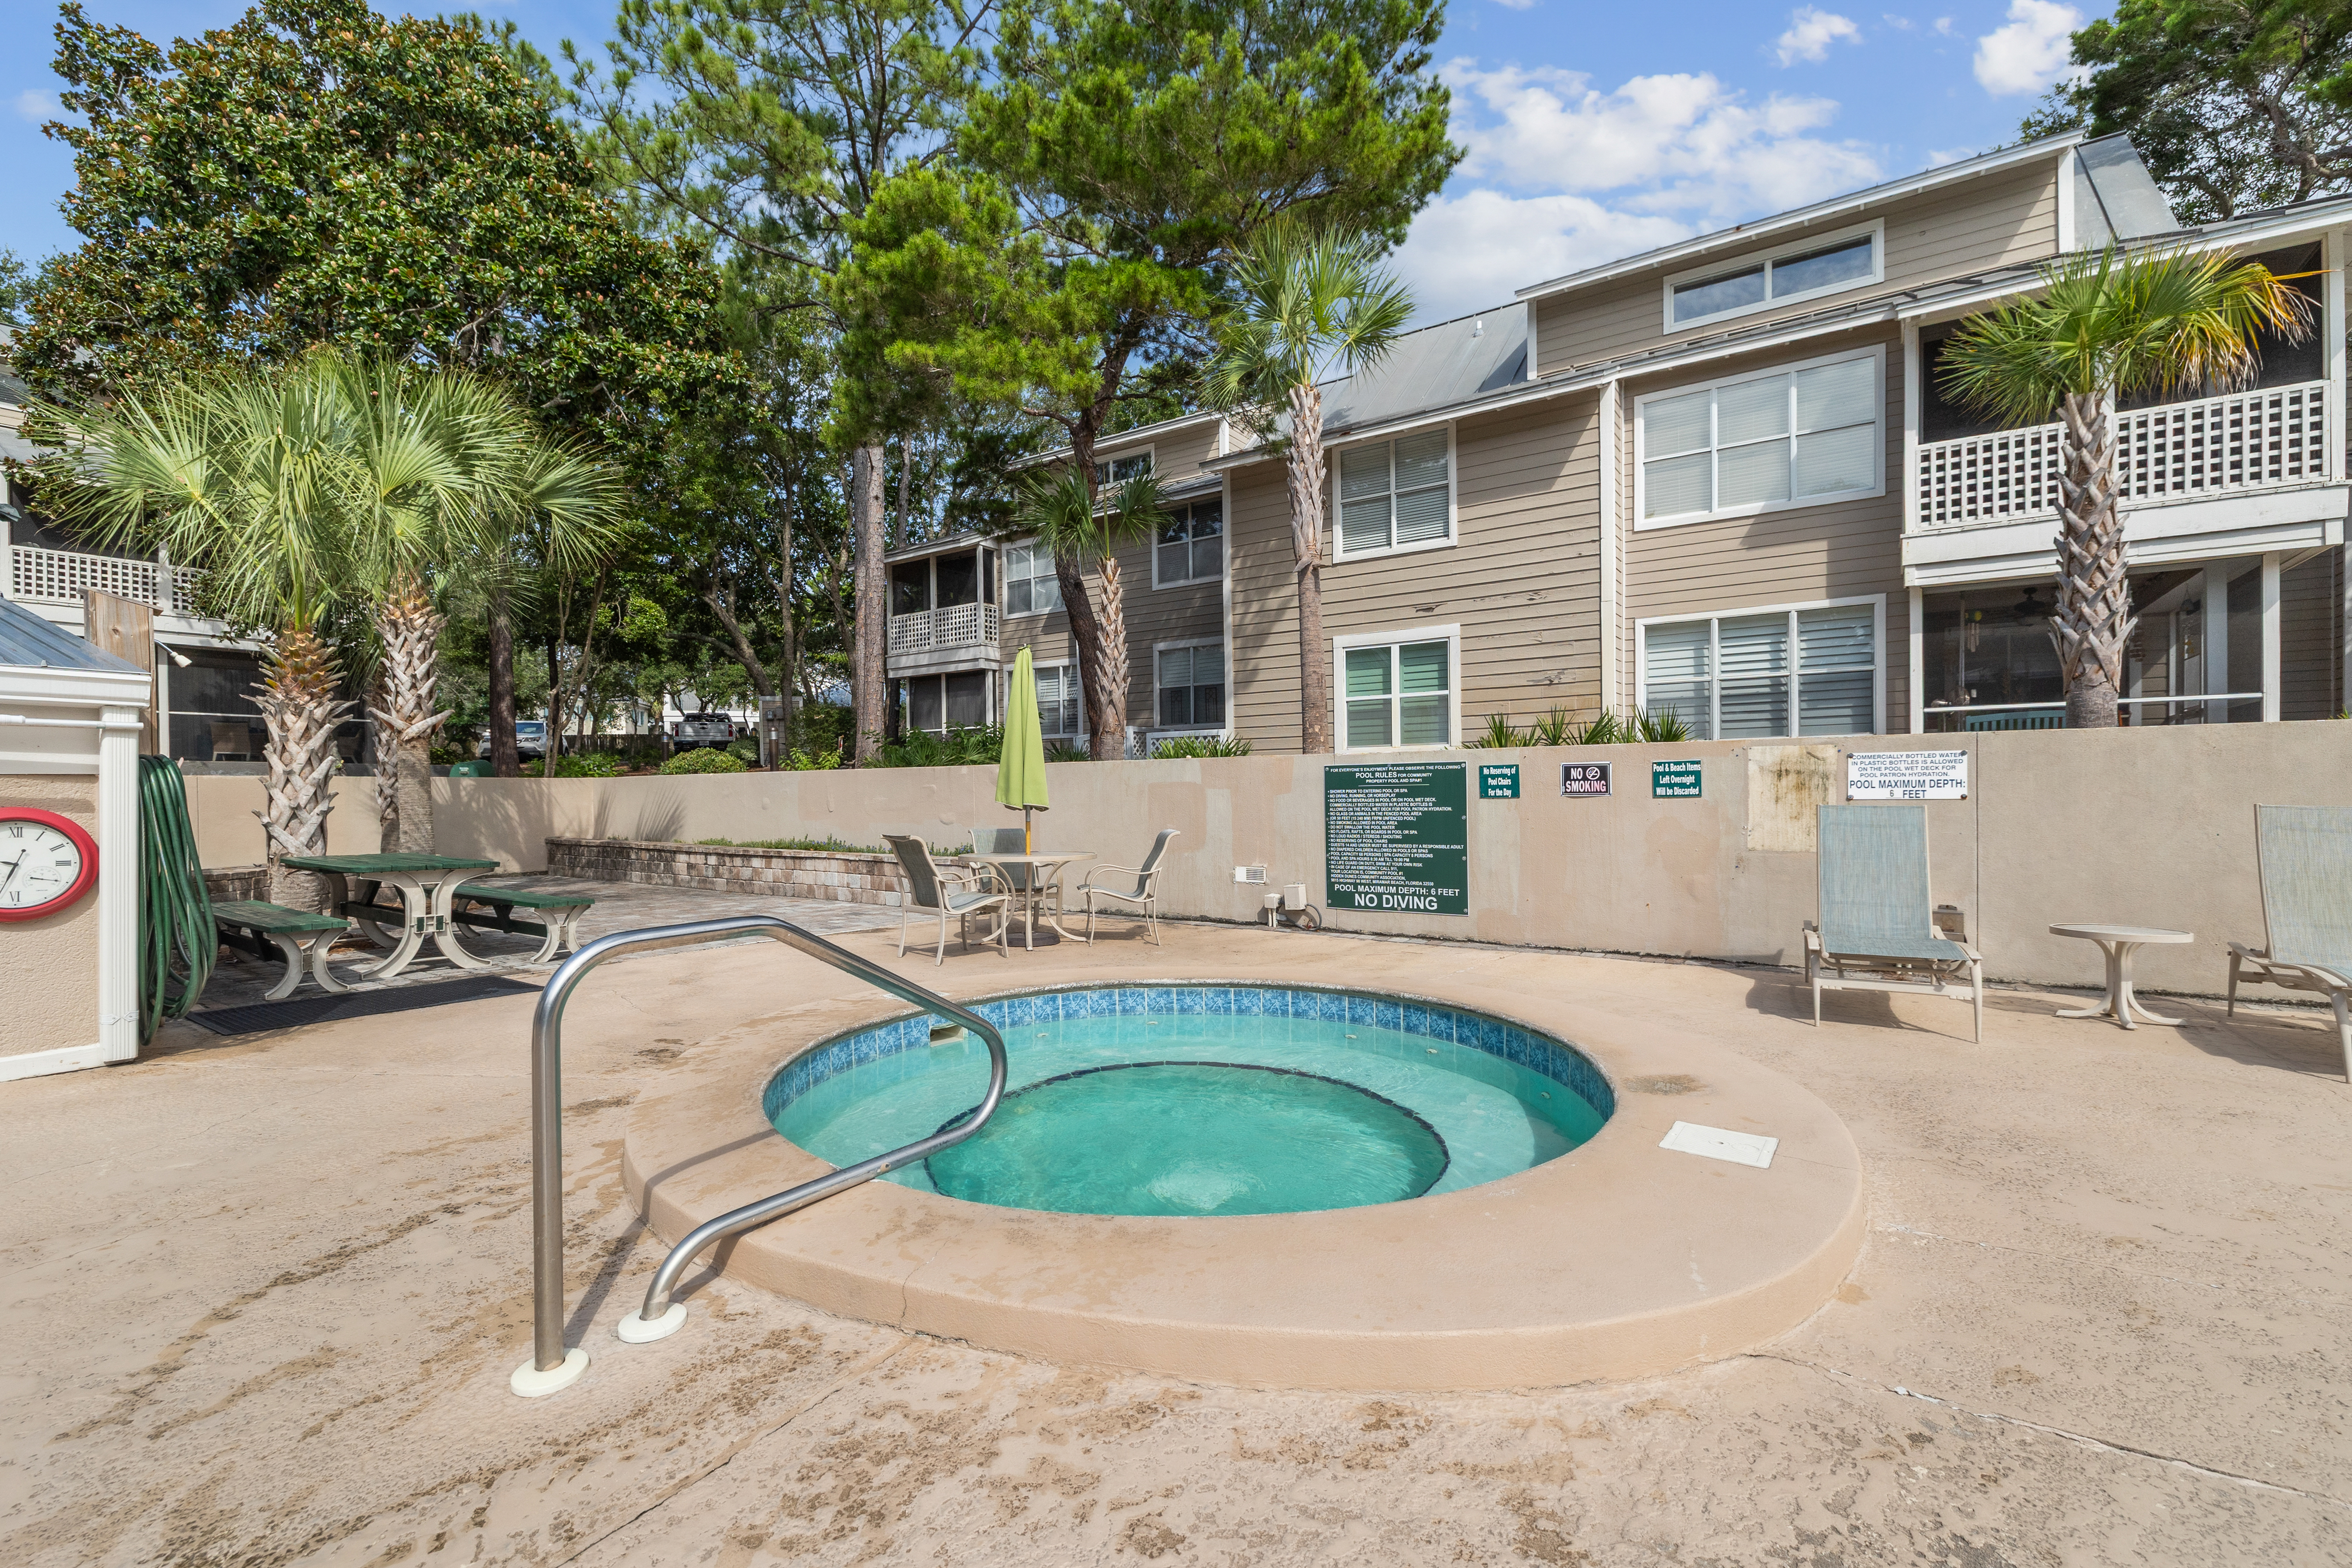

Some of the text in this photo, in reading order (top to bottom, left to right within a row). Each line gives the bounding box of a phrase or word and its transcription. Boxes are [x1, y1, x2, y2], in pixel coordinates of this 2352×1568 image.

[1490, 767, 1510, 776] Reserving
[1653, 763, 1701, 772] Pool & Beach Items
[1571, 768, 1583, 779] NO
[1660, 775, 1695, 785] Left Overnight
[1850, 780, 1965, 789] POOL MAXIMUM DEPTH:
[1566, 781, 1606, 792] SMOKING
[1667, 787, 1673, 795] be
[1674, 787, 1699, 795] Discarded
[1902, 790, 1927, 798] FEET
[9, 827, 24, 838] XII
[9, 891, 21, 902] VI
[1355, 894, 1437, 910] NO DIVING
